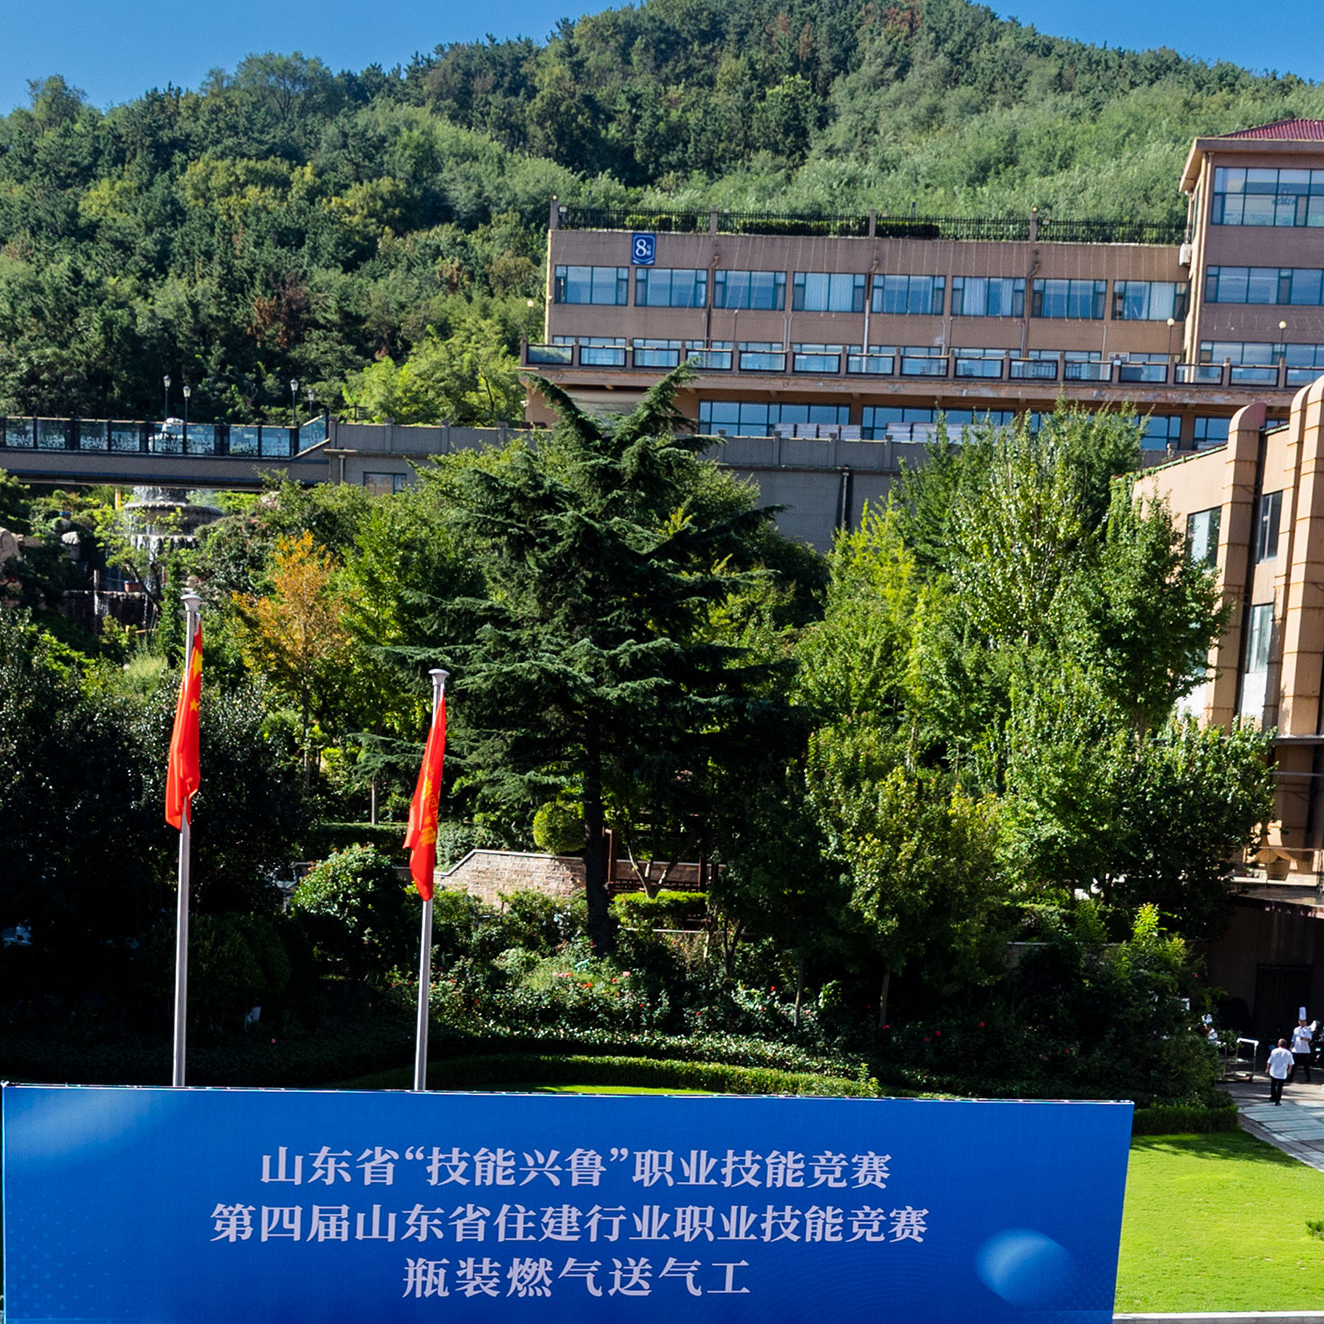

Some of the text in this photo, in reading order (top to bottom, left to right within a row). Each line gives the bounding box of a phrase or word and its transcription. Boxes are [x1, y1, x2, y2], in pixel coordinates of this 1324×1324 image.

[260, 1145, 892, 1190] 山东省“技能兴鲁”职业技能竞赛
[209, 1202, 929, 1243] 第四届山东省住建行业职业技能竞赛
[402, 1257, 752, 1299] 瓶装燃气送气工
